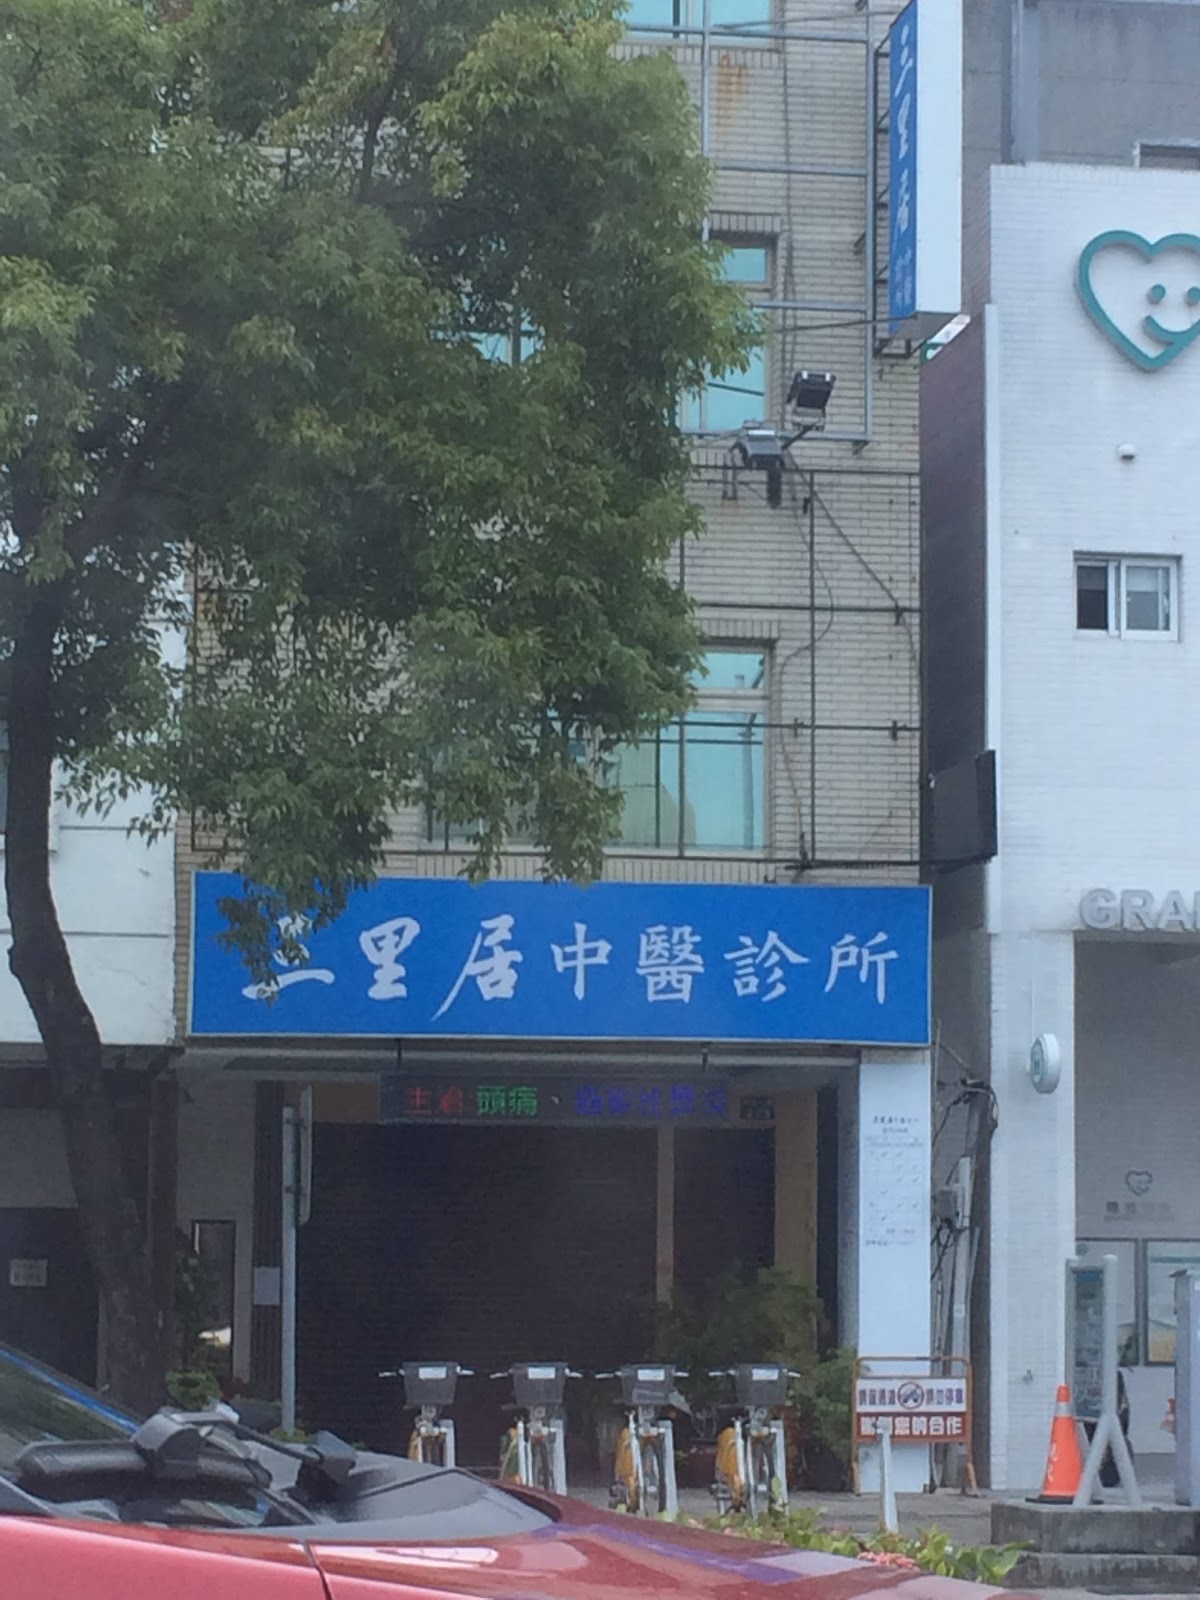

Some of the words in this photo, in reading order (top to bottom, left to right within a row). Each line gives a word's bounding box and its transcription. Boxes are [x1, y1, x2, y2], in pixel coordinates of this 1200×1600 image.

[1079, 888, 1200, 931] GRA
[241, 911, 899, 1021] 三里居中醫診所
